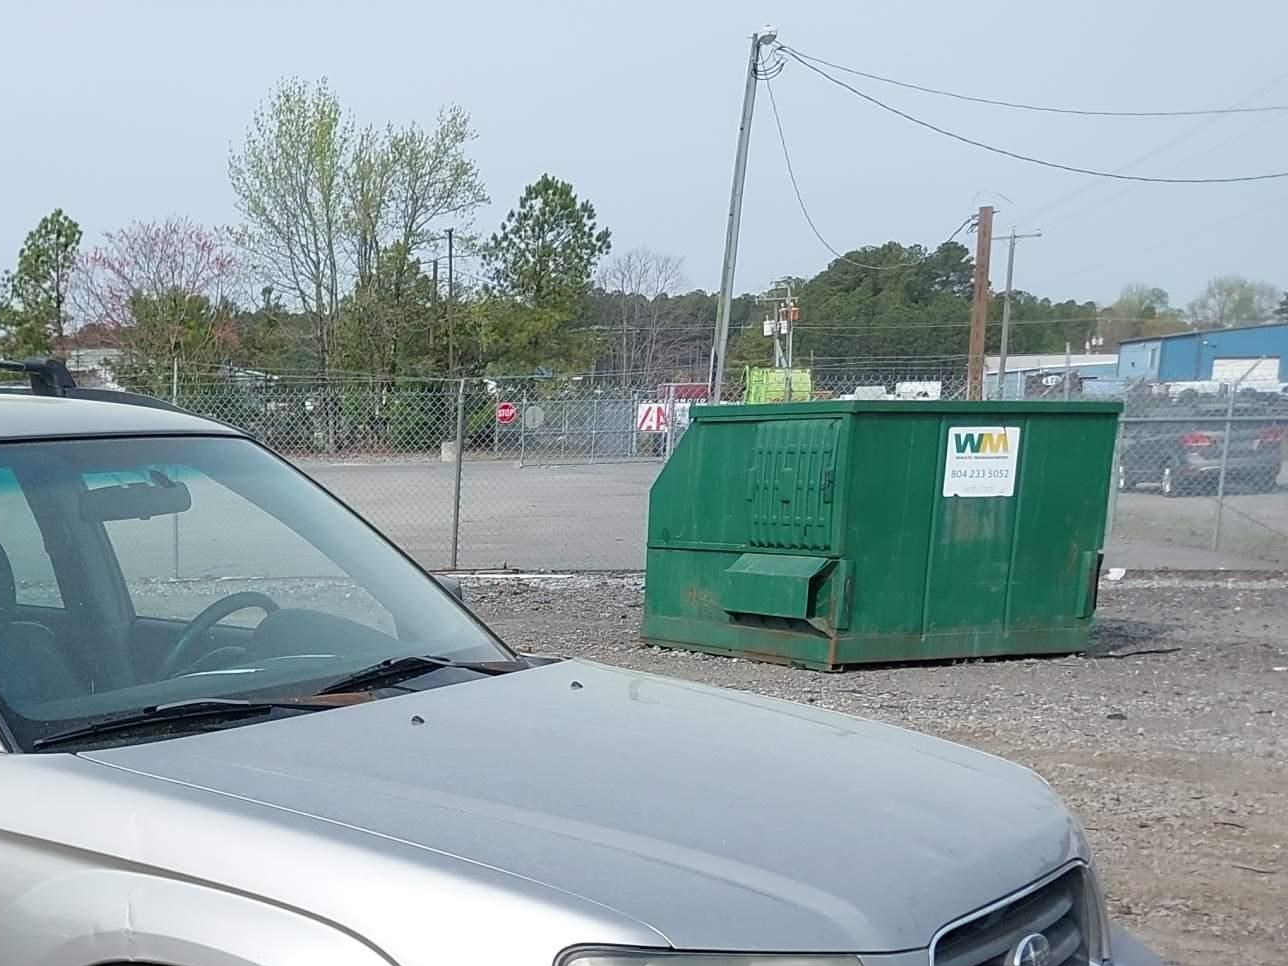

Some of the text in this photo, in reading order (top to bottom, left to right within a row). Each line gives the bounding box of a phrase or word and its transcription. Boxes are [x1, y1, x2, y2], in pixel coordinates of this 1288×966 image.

[497, 408, 515, 418] STOP
[954, 432, 1009, 453] WM
[951, 469, 1009, 479] 804 233 5052
